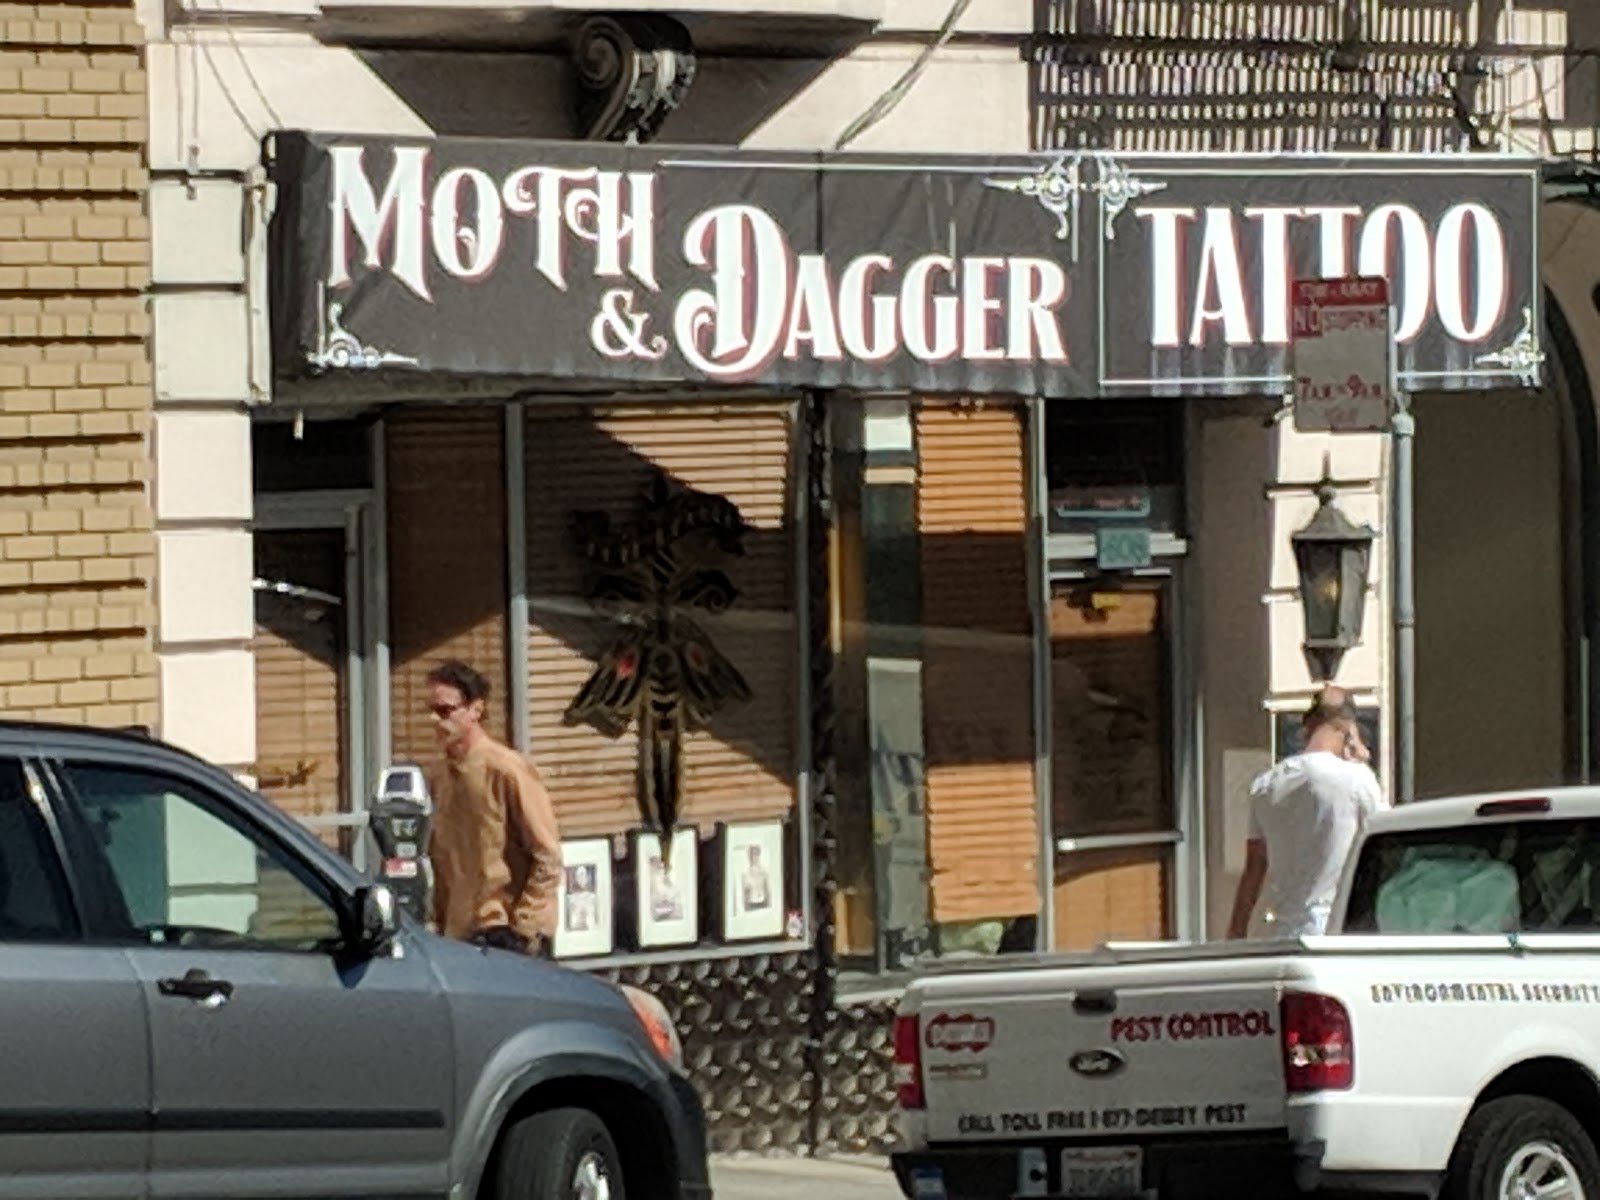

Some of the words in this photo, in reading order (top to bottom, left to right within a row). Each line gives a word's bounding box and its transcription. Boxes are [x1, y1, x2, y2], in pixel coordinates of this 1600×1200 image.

[328, 146, 661, 303] MOTH
[591, 288, 668, 359] &
[674, 203, 1069, 377] DAGGER
[1135, 202, 1510, 346] TATTOO
[1111, 1015, 1163, 1042] PEST
[1167, 1009, 1275, 1041] CONTROL
